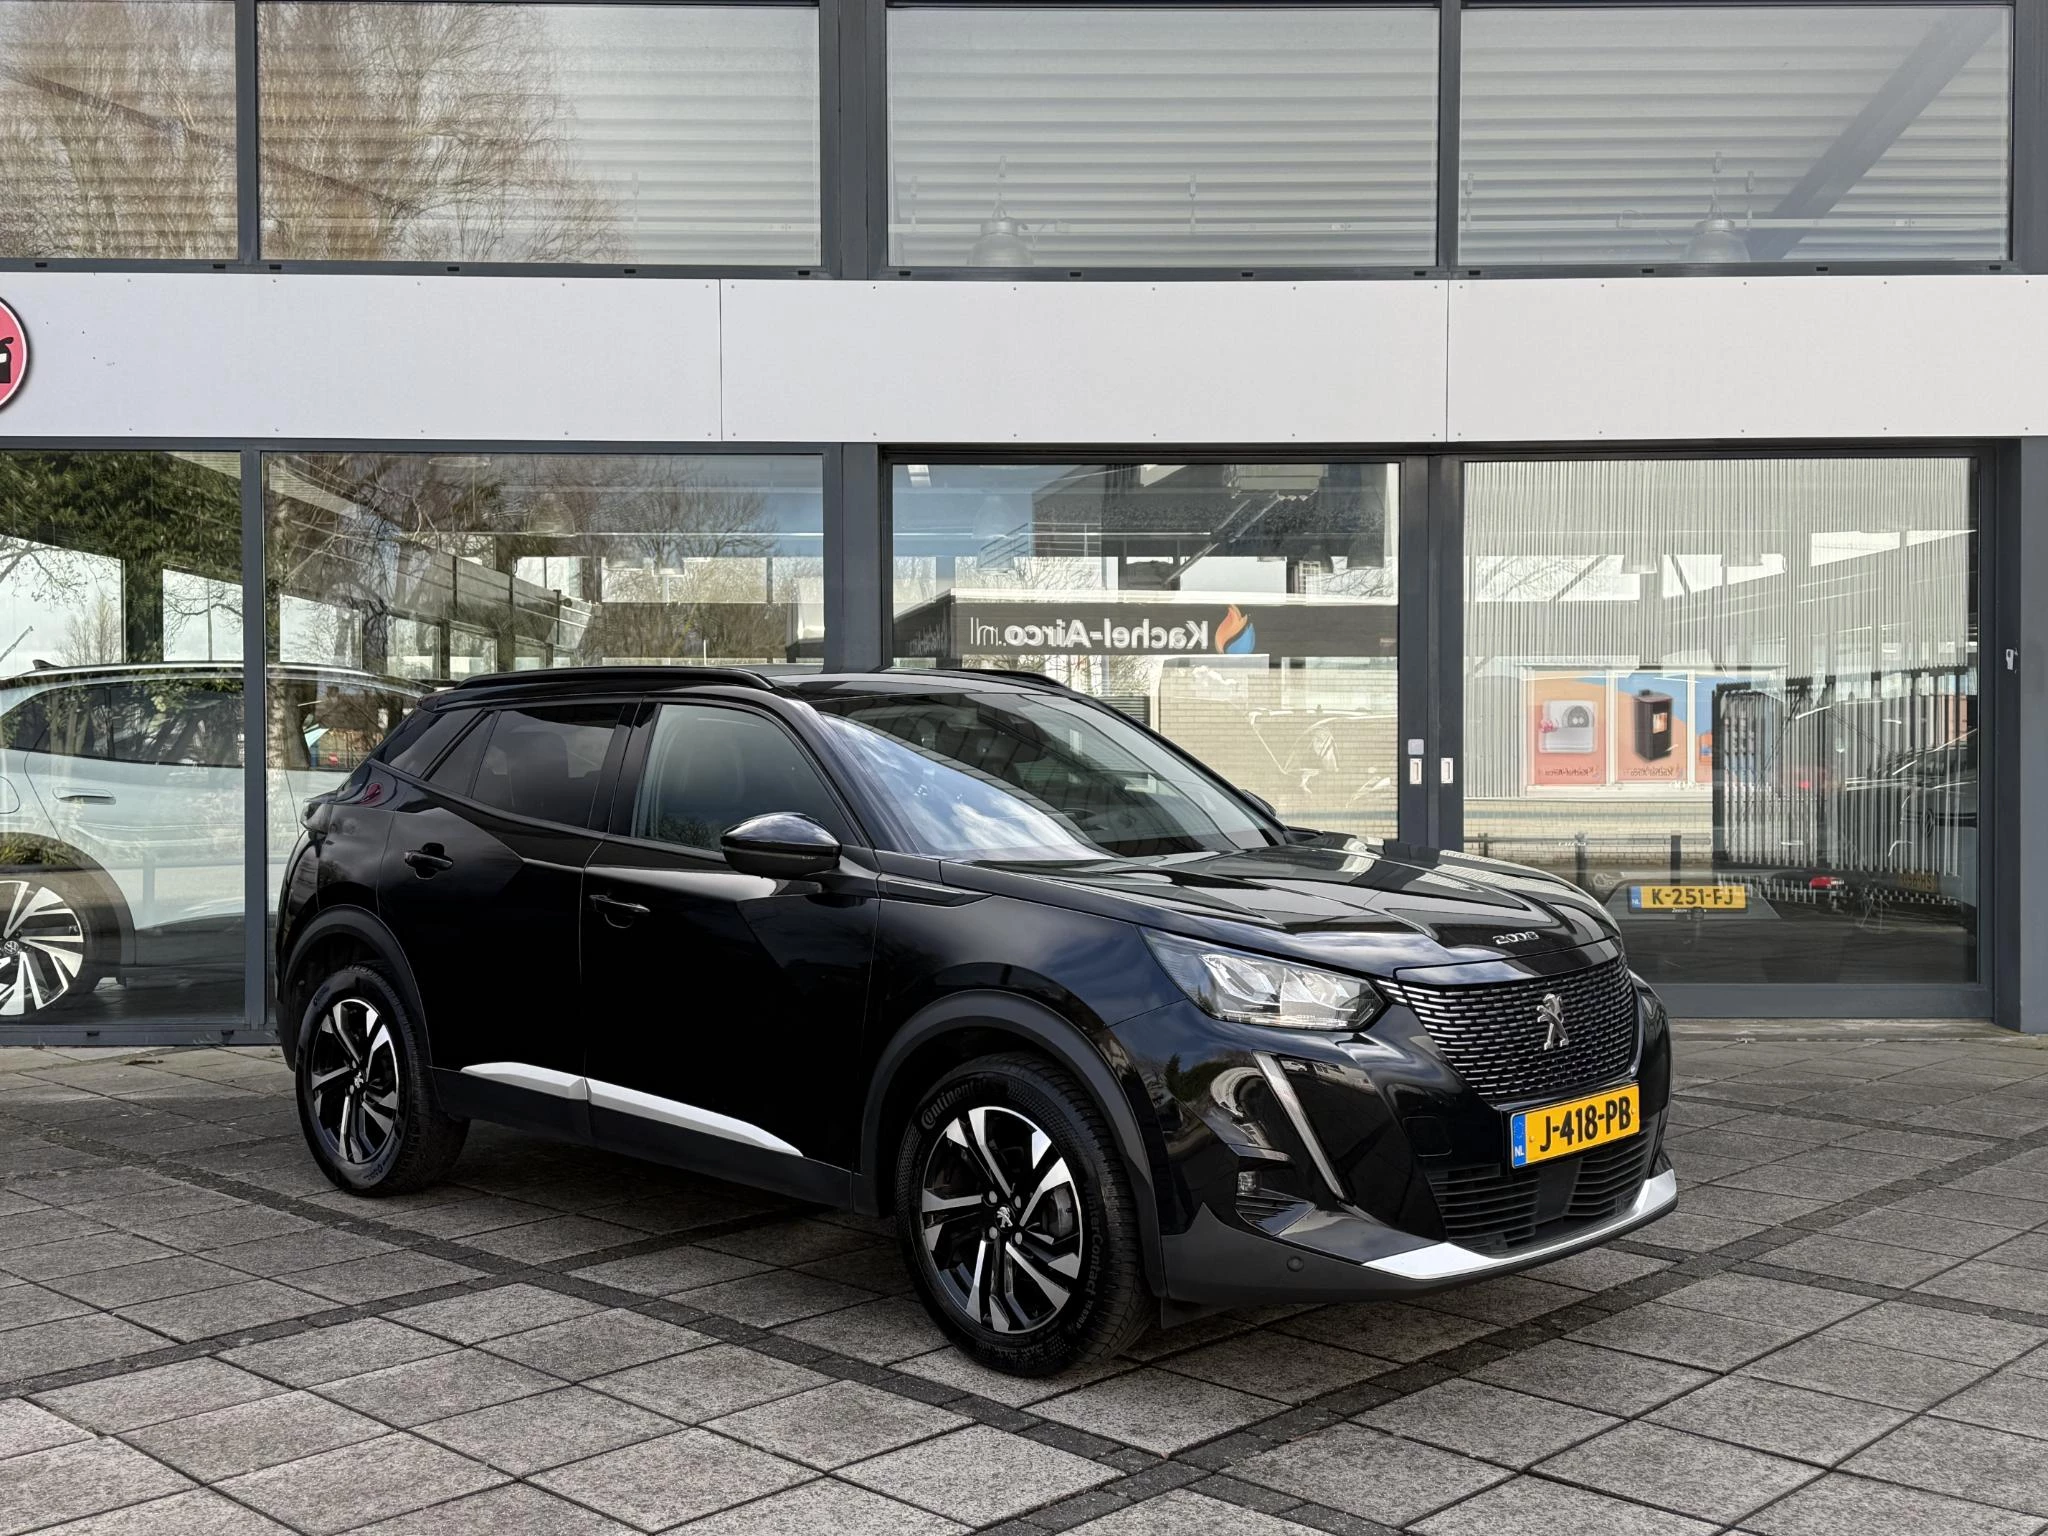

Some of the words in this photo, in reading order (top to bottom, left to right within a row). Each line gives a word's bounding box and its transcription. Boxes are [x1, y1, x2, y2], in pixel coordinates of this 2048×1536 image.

[1651, 888, 1734, 905] K-251-FJ
[1539, 1096, 1632, 1153] J-418-PB
[1514, 1145, 1525, 1157] NL
